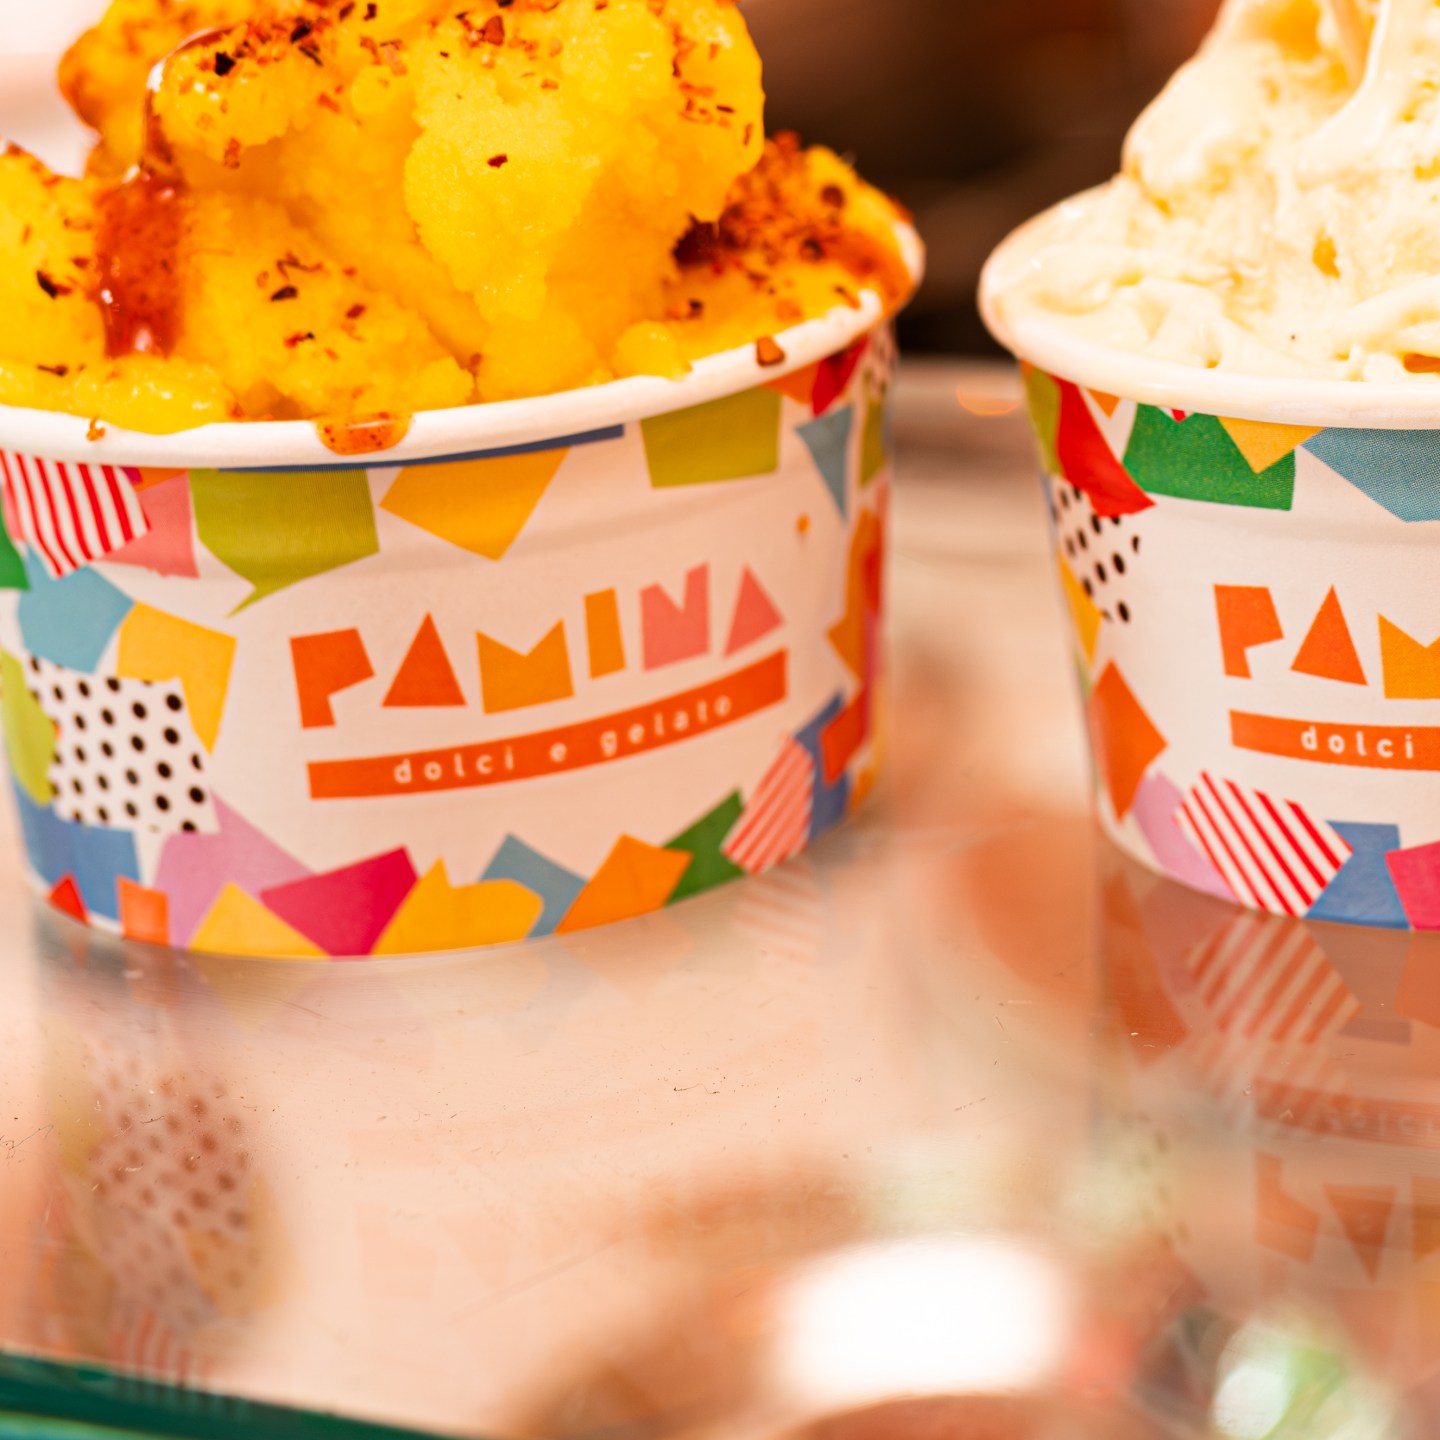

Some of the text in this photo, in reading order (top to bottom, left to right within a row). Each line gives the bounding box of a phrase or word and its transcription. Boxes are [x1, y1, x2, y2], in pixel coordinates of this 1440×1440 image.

[289, 561, 785, 730] PAMINA
[393, 694, 733, 784] dolci e gelato
[1300, 725, 1414, 761] dolci
